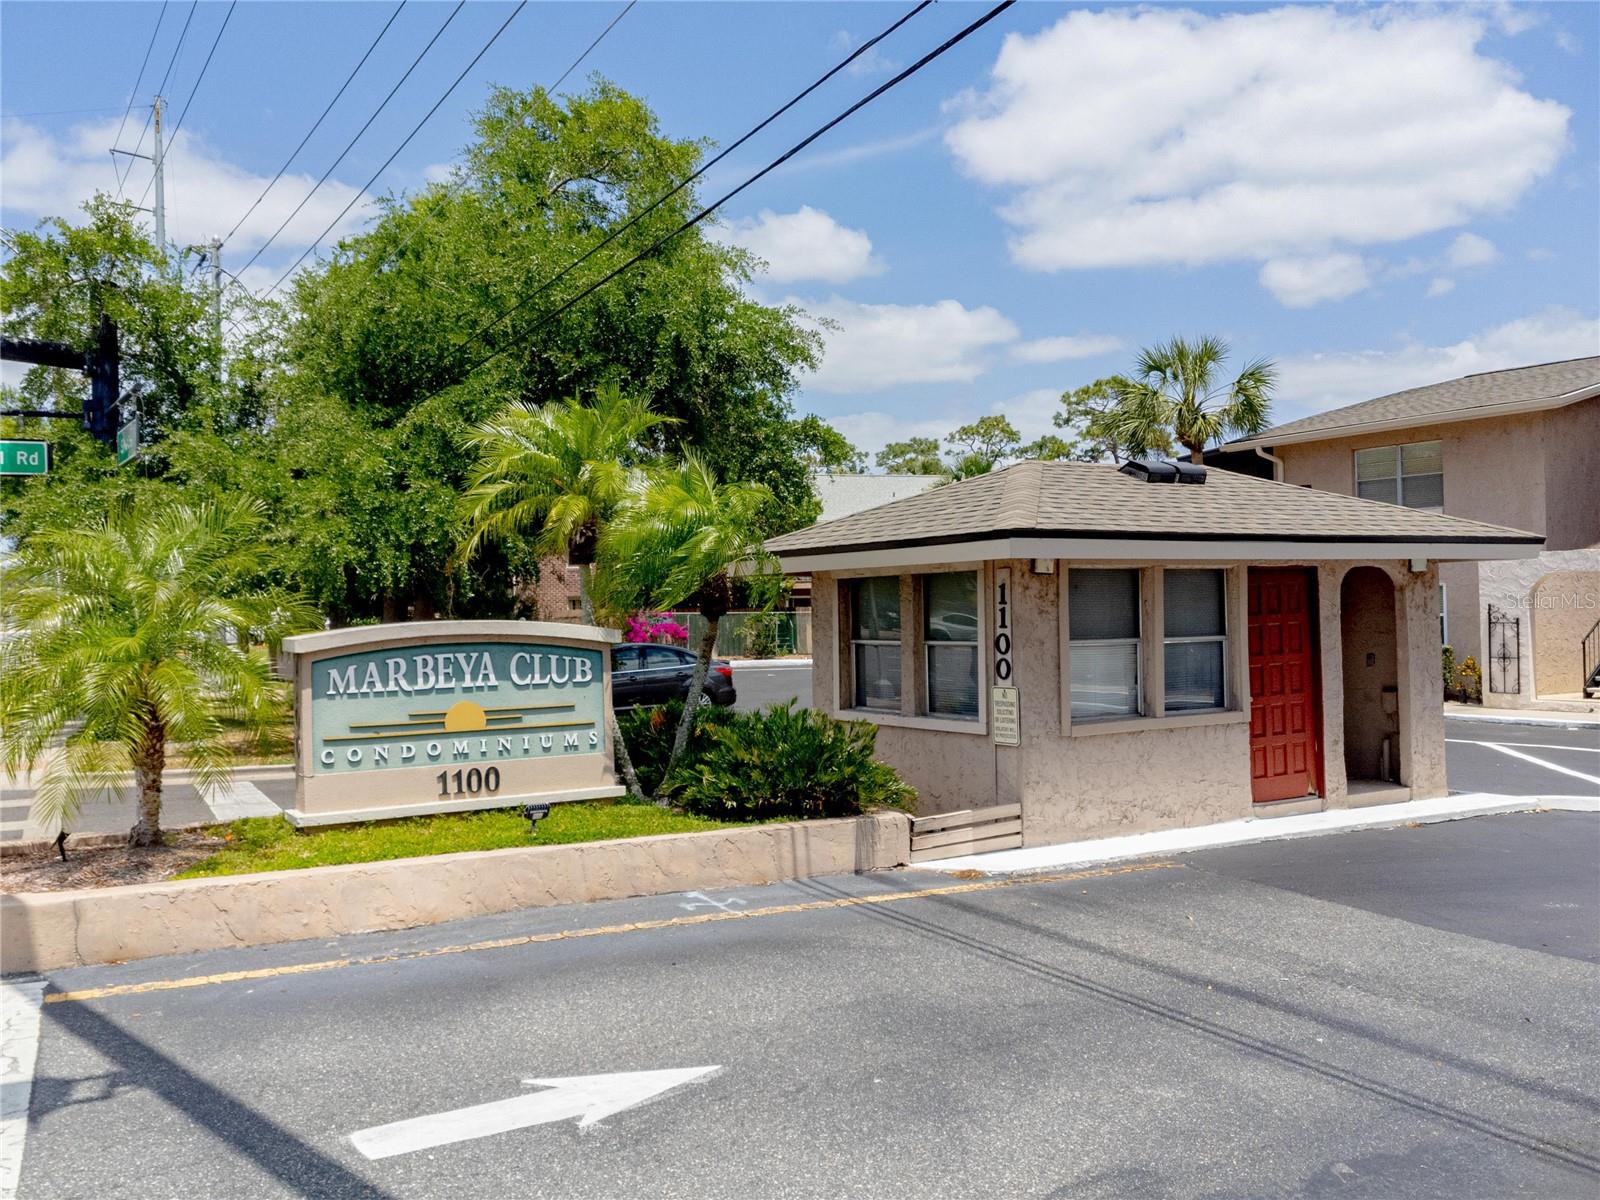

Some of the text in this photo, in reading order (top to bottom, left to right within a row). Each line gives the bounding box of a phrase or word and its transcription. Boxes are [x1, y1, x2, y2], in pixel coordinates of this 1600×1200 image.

[16, 451, 39, 465] Rd
[995, 583, 1011, 680] 1100
[326, 652, 592, 694] MARBEYA CLUB
[321, 731, 599, 764] CONDOMINIUMS
[437, 766, 500, 795] 1100
